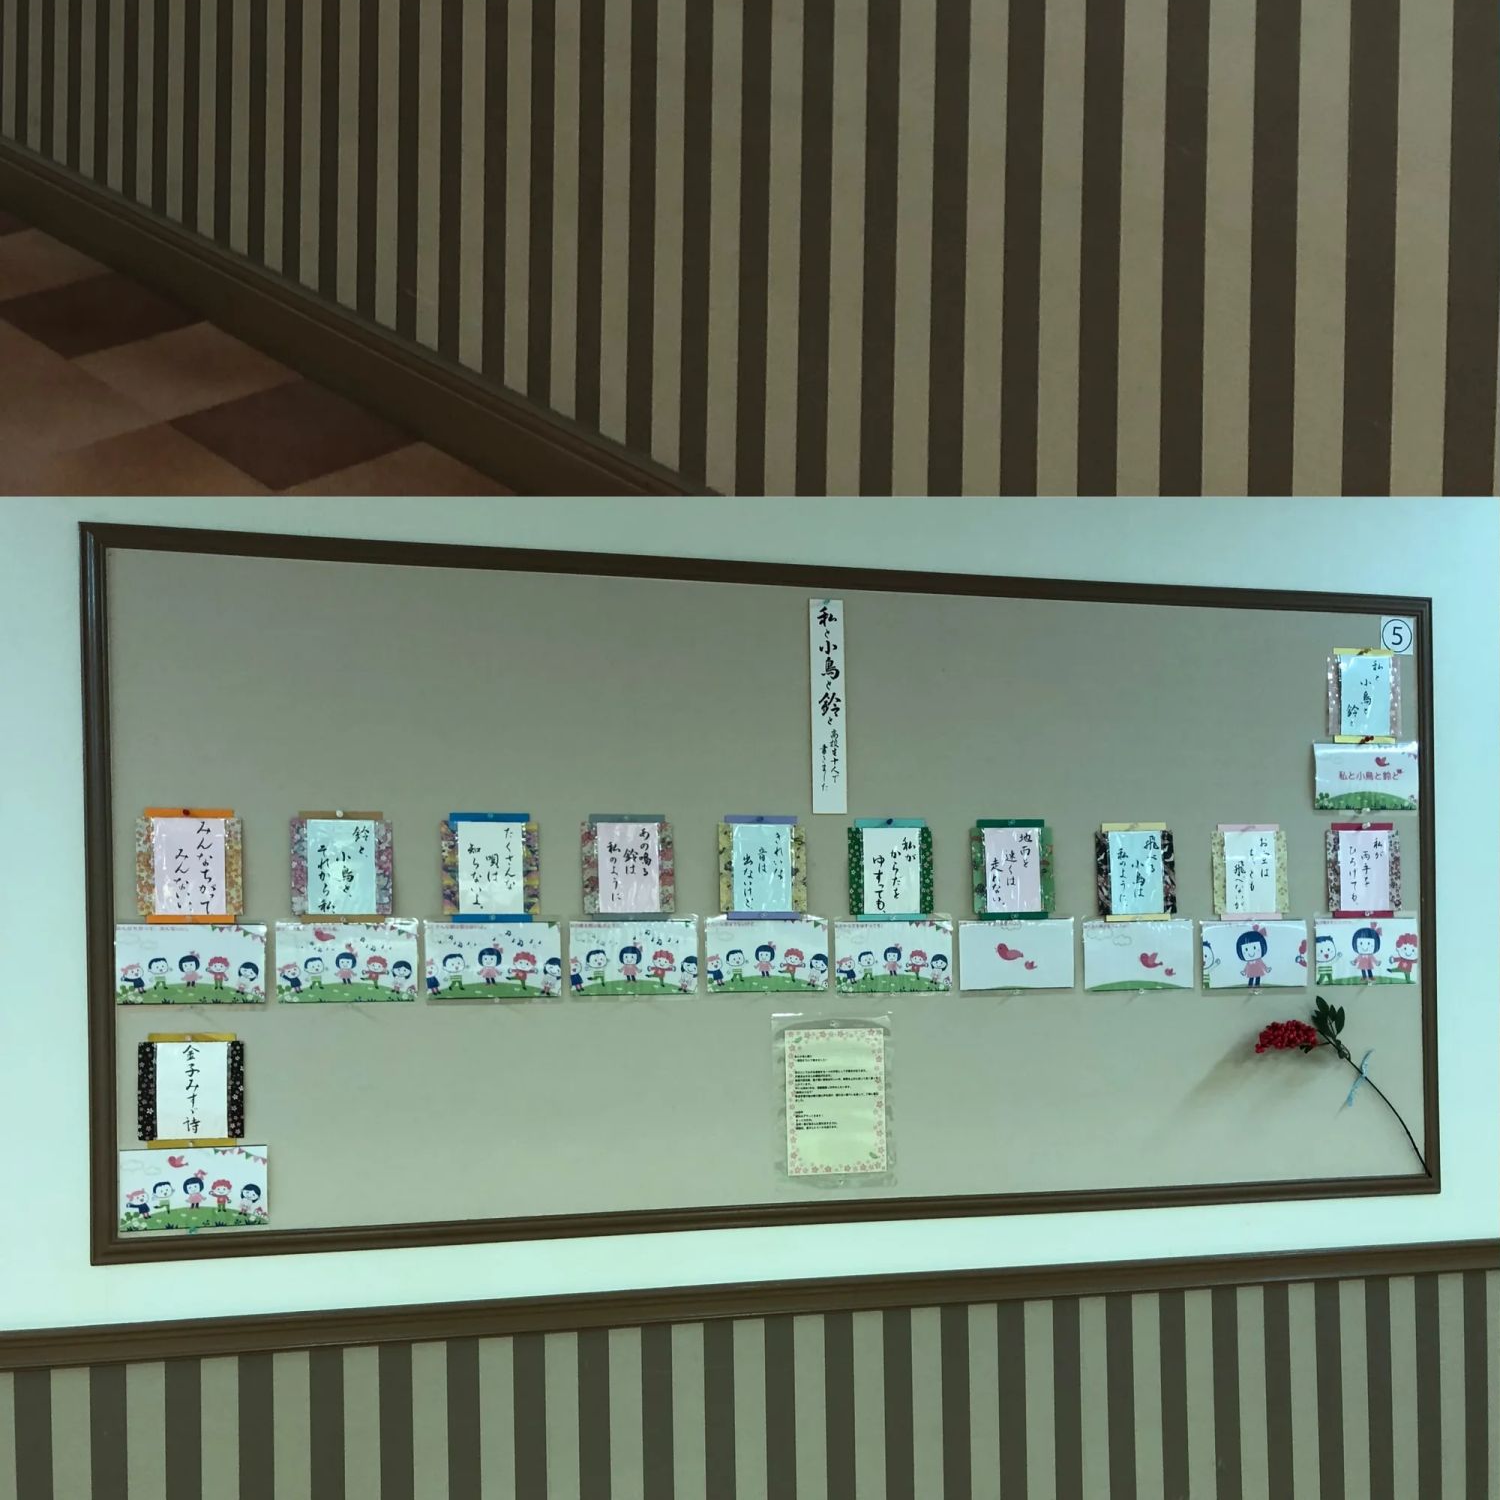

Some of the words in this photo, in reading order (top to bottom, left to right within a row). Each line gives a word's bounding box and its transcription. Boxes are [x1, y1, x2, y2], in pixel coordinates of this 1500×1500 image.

[817, 606, 841, 725] 私と小鳥と鈴と
[1339, 770, 1399, 780] 私と小鳥と鈴と
[623, 848, 638, 875] 鈴は
[638, 829, 653, 877] あの鳴る
[902, 837, 917, 863] 私が
[1373, 837, 1385, 861] 私が
[486, 853, 500, 882] 唄は
[1131, 859, 1145, 899] 小鳥は
